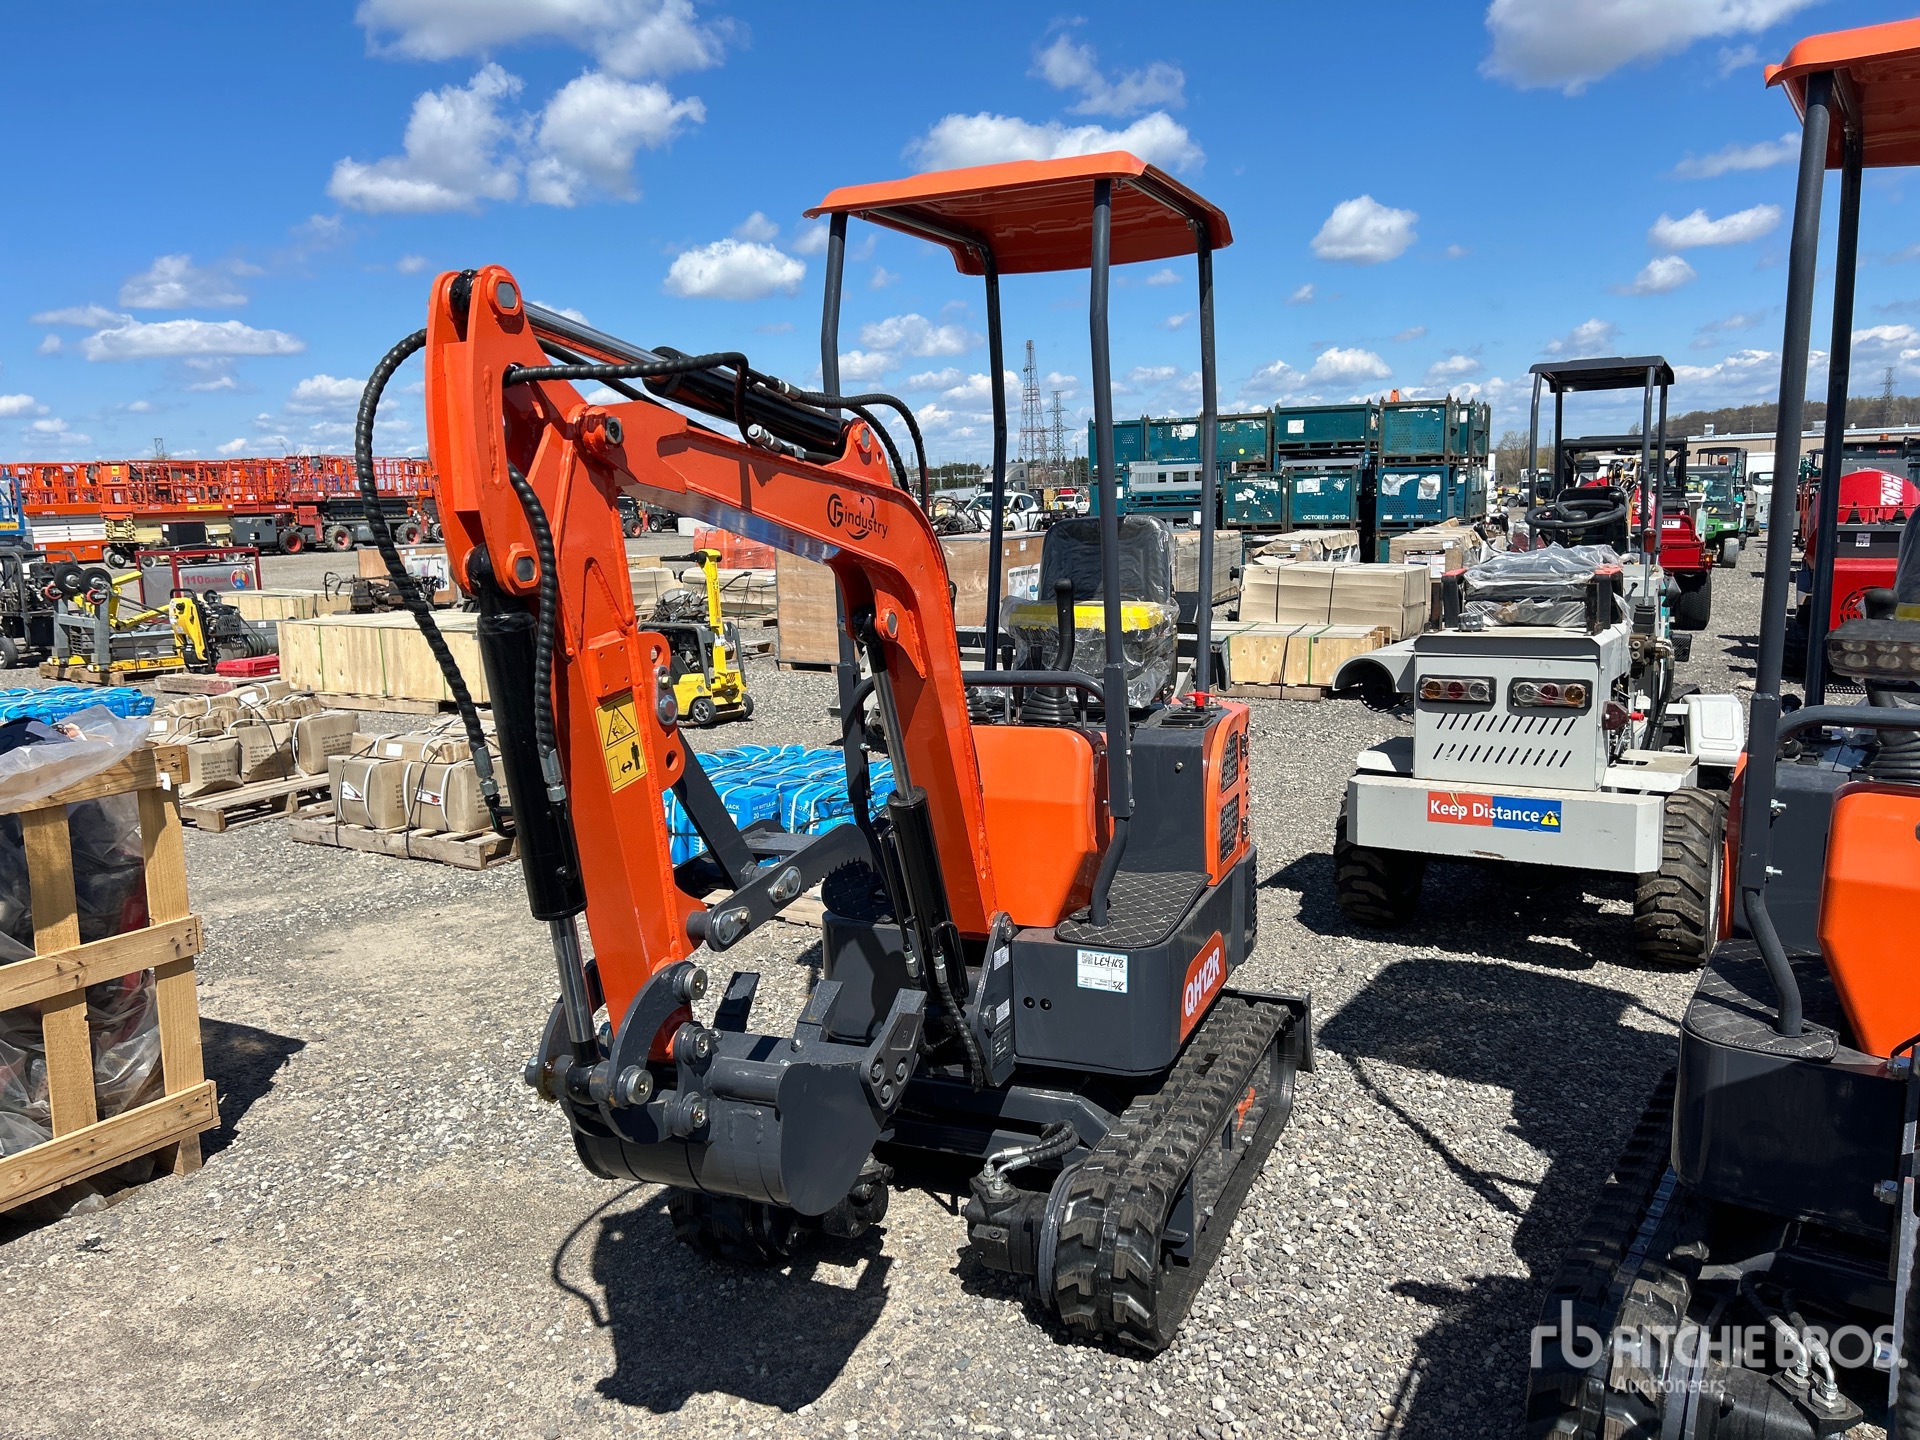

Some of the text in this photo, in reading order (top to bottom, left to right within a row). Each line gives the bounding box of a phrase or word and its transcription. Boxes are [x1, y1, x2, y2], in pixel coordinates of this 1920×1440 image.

[184, 575, 228, 585] 110 Gallon
[1430, 799, 1540, 823] Keep Distance
[1185, 946, 1221, 1018] QH12R
